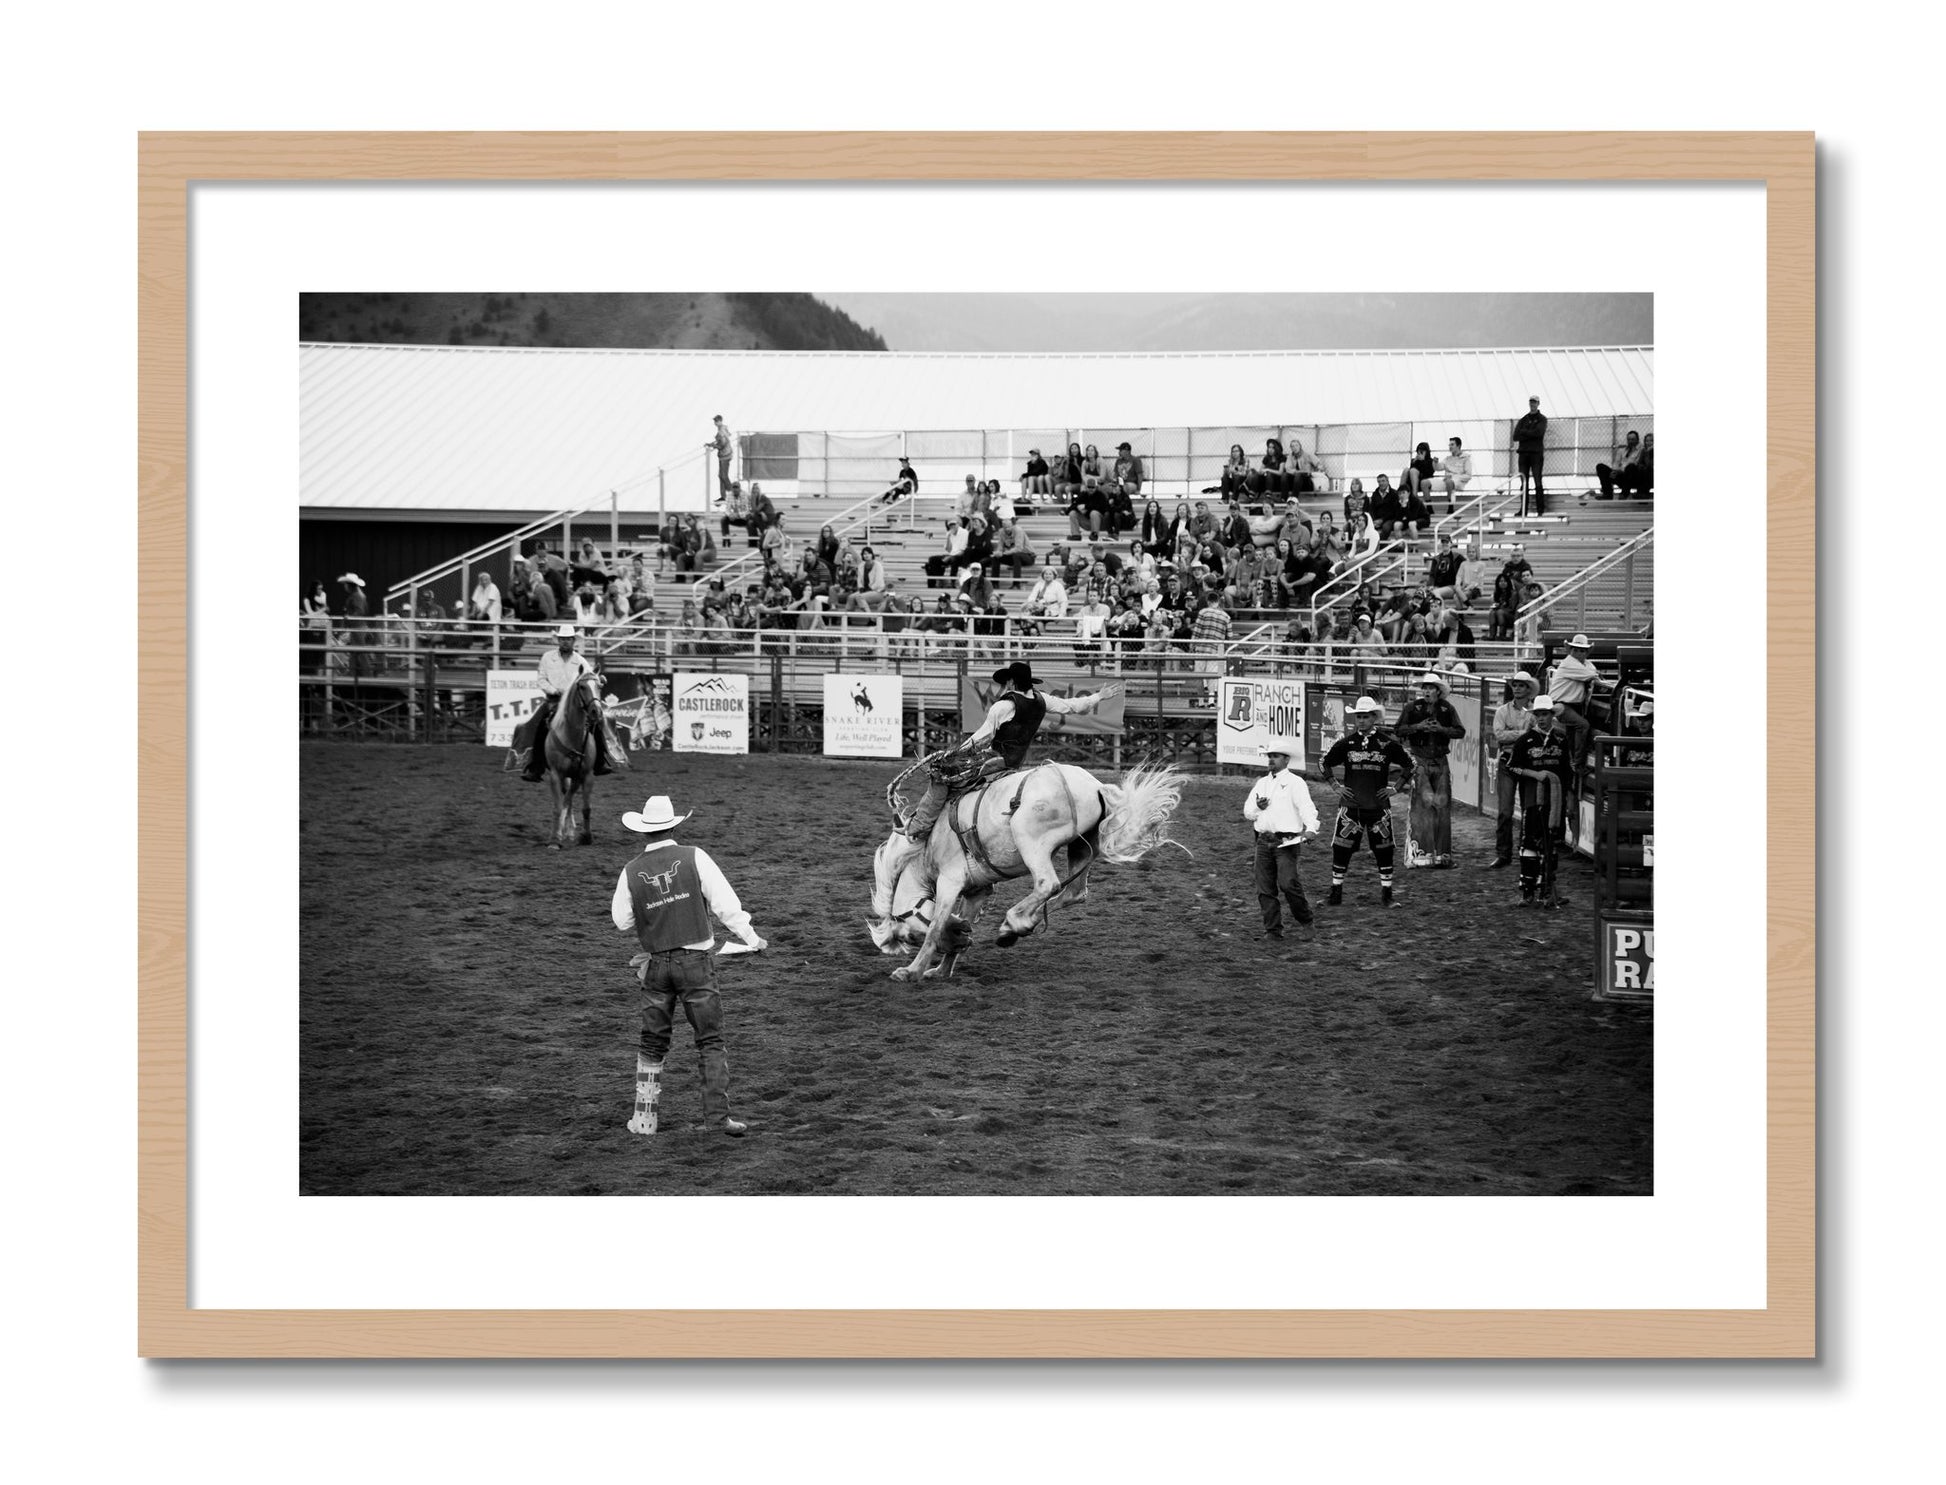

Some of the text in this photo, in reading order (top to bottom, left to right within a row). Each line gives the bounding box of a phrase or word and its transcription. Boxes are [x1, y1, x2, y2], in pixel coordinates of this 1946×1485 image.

[490, 679, 508, 689] TETON
[509, 679, 528, 689] TRASH
[1255, 683, 1302, 706] RANCH
[678, 697, 745, 712] CASTLEROCK
[825, 716, 901, 726] SNAKE RIVER
[1256, 710, 1268, 724] AND
[1269, 705, 1302, 738] HOME
[709, 727, 732, 739] Jeep
[646, 901, 664, 909] Jackson
